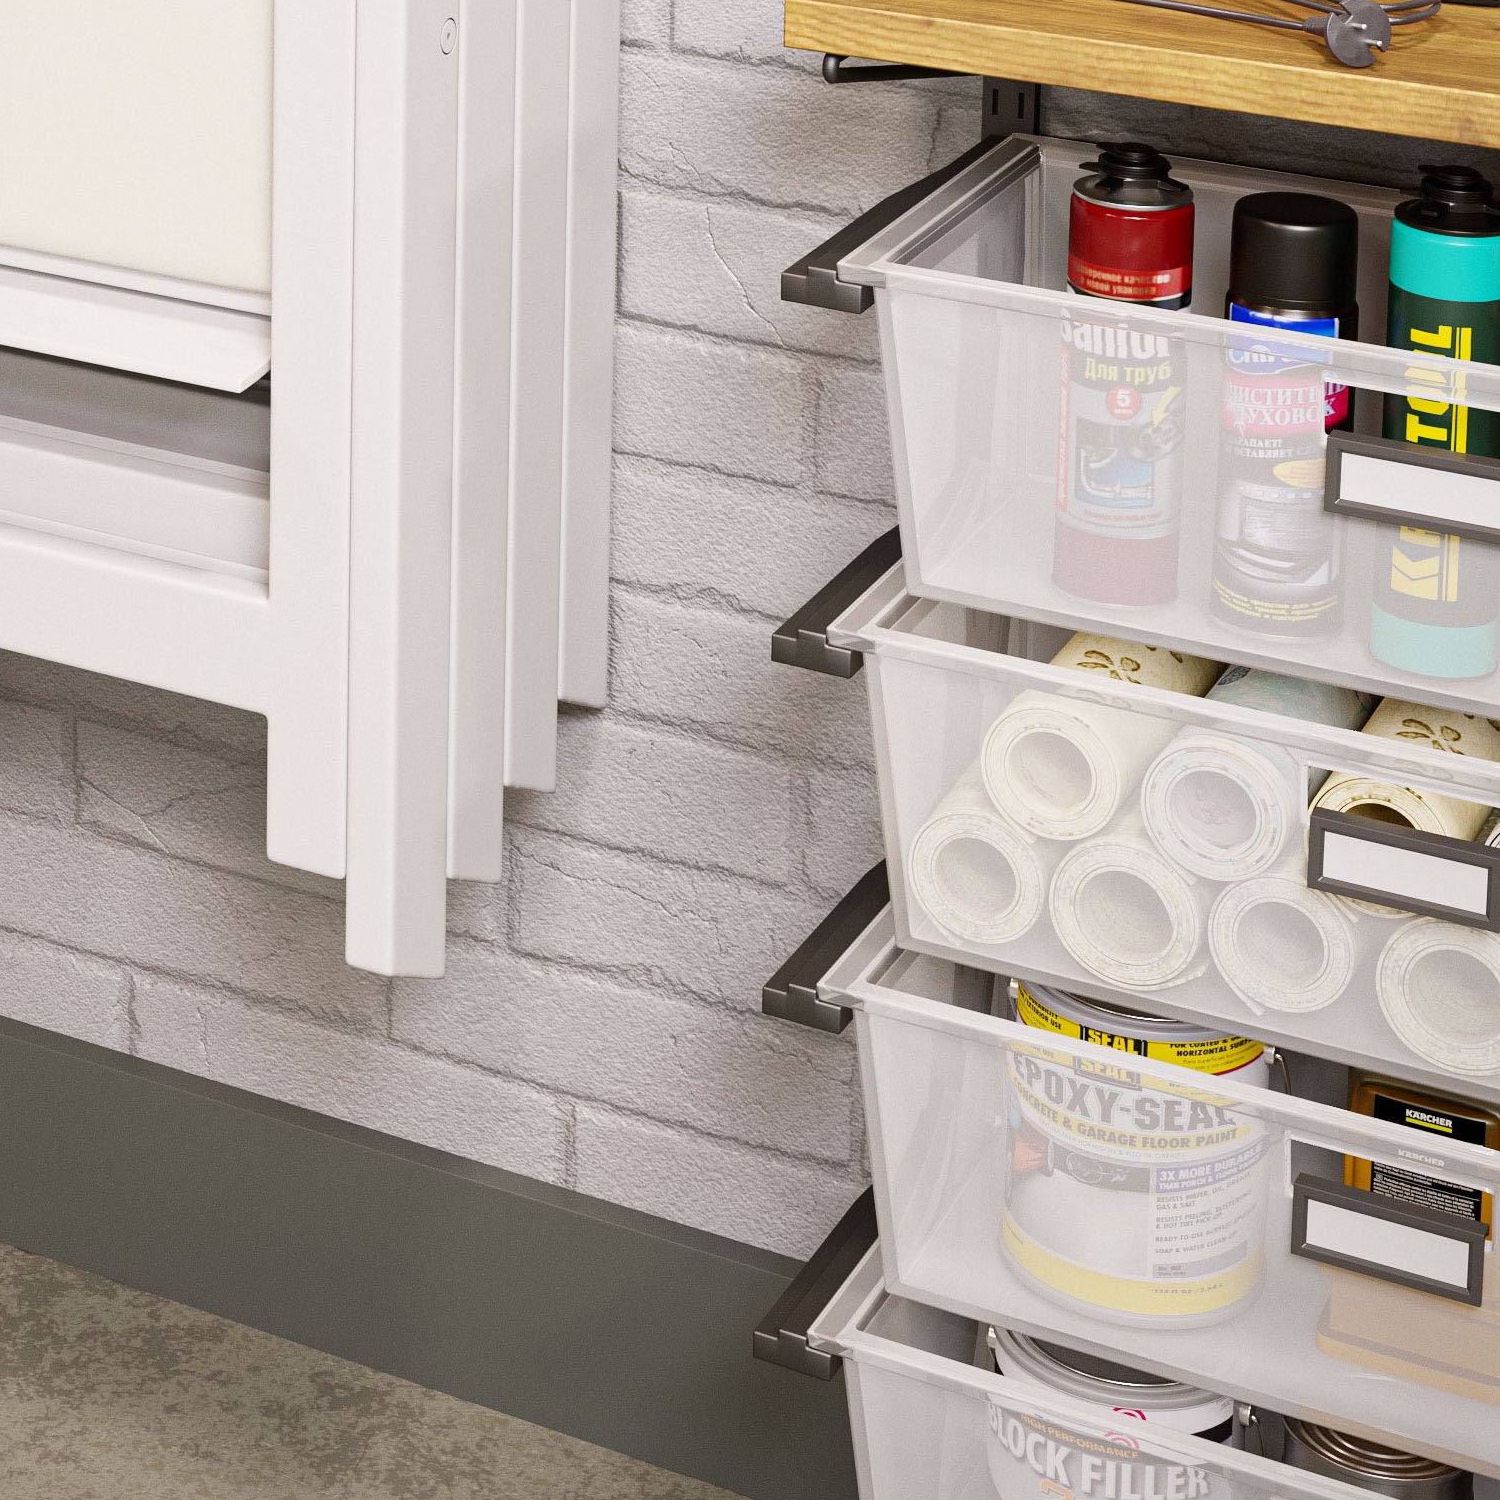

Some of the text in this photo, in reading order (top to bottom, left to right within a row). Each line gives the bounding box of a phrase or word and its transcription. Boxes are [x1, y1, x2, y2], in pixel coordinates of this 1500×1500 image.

[1084, 358, 1171, 385] Для труб
[1116, 388, 1131, 408] 5
[1176, 1046, 1228, 1058] HORIZONTAL
[1013, 1052, 1238, 1133] EPOXY-SEAL
[1012, 1076, 1059, 1123] CONCRETE
[1062, 1115, 1073, 1131] &
[1077, 1123, 1138, 1148] GARAGE
[1141, 1135, 1190, 1149] FLOOR
[1195, 1127, 1239, 1147] PAINT
[1405, 1108, 1453, 1128] KÄRCHER
[1160, 1170, 1176, 1182] 3X
[1178, 1164, 1212, 1180] MORE
[1159, 1181, 1181, 1191] THAN
[1156, 1204, 1171, 1212] GAS
[1019, 1412, 1140, 1460] HIGH PERFORMANCE
[988, 1403, 1210, 1500] BLOCK FILLER
